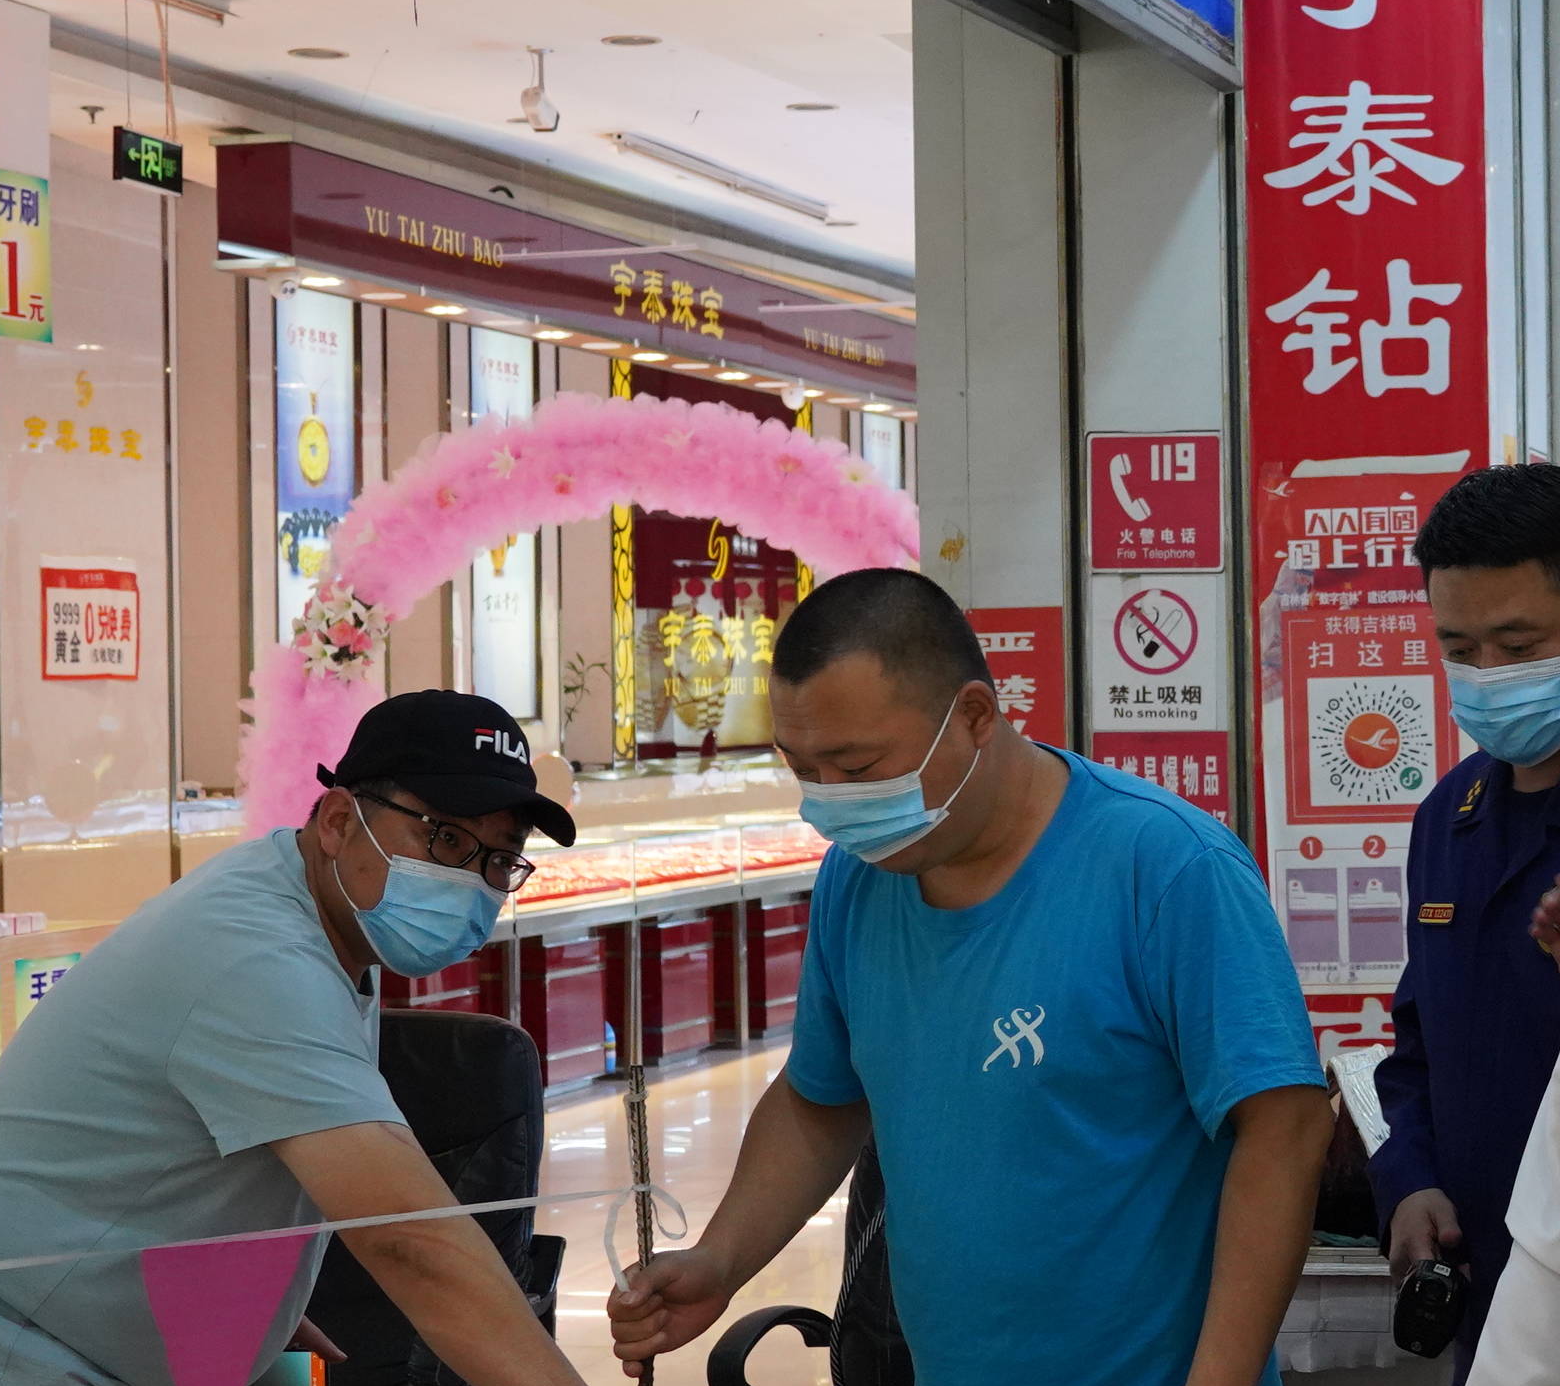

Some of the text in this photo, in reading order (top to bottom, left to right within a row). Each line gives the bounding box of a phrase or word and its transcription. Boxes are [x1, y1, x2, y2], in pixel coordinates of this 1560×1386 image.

[365, 205, 504, 269] YU TAI ZHU BAO
[0, 239, 46, 324] 1元
[609, 259, 724, 340] 宇泰珠宝
[1150, 442, 1196, 481] 119
[1119, 527, 1197, 545] 火警电话
[1142, 547, 1197, 561] Telephone
[659, 609, 775, 667] 宇泰珠宝
[1324, 614, 1417, 635] 获得吉祥码
[1307, 639, 1429, 668] 扫这里
[1108, 685, 1202, 705] 禁止吸烟
[1113, 707, 1198, 721] No smoking
[473, 728, 528, 763] FILA
